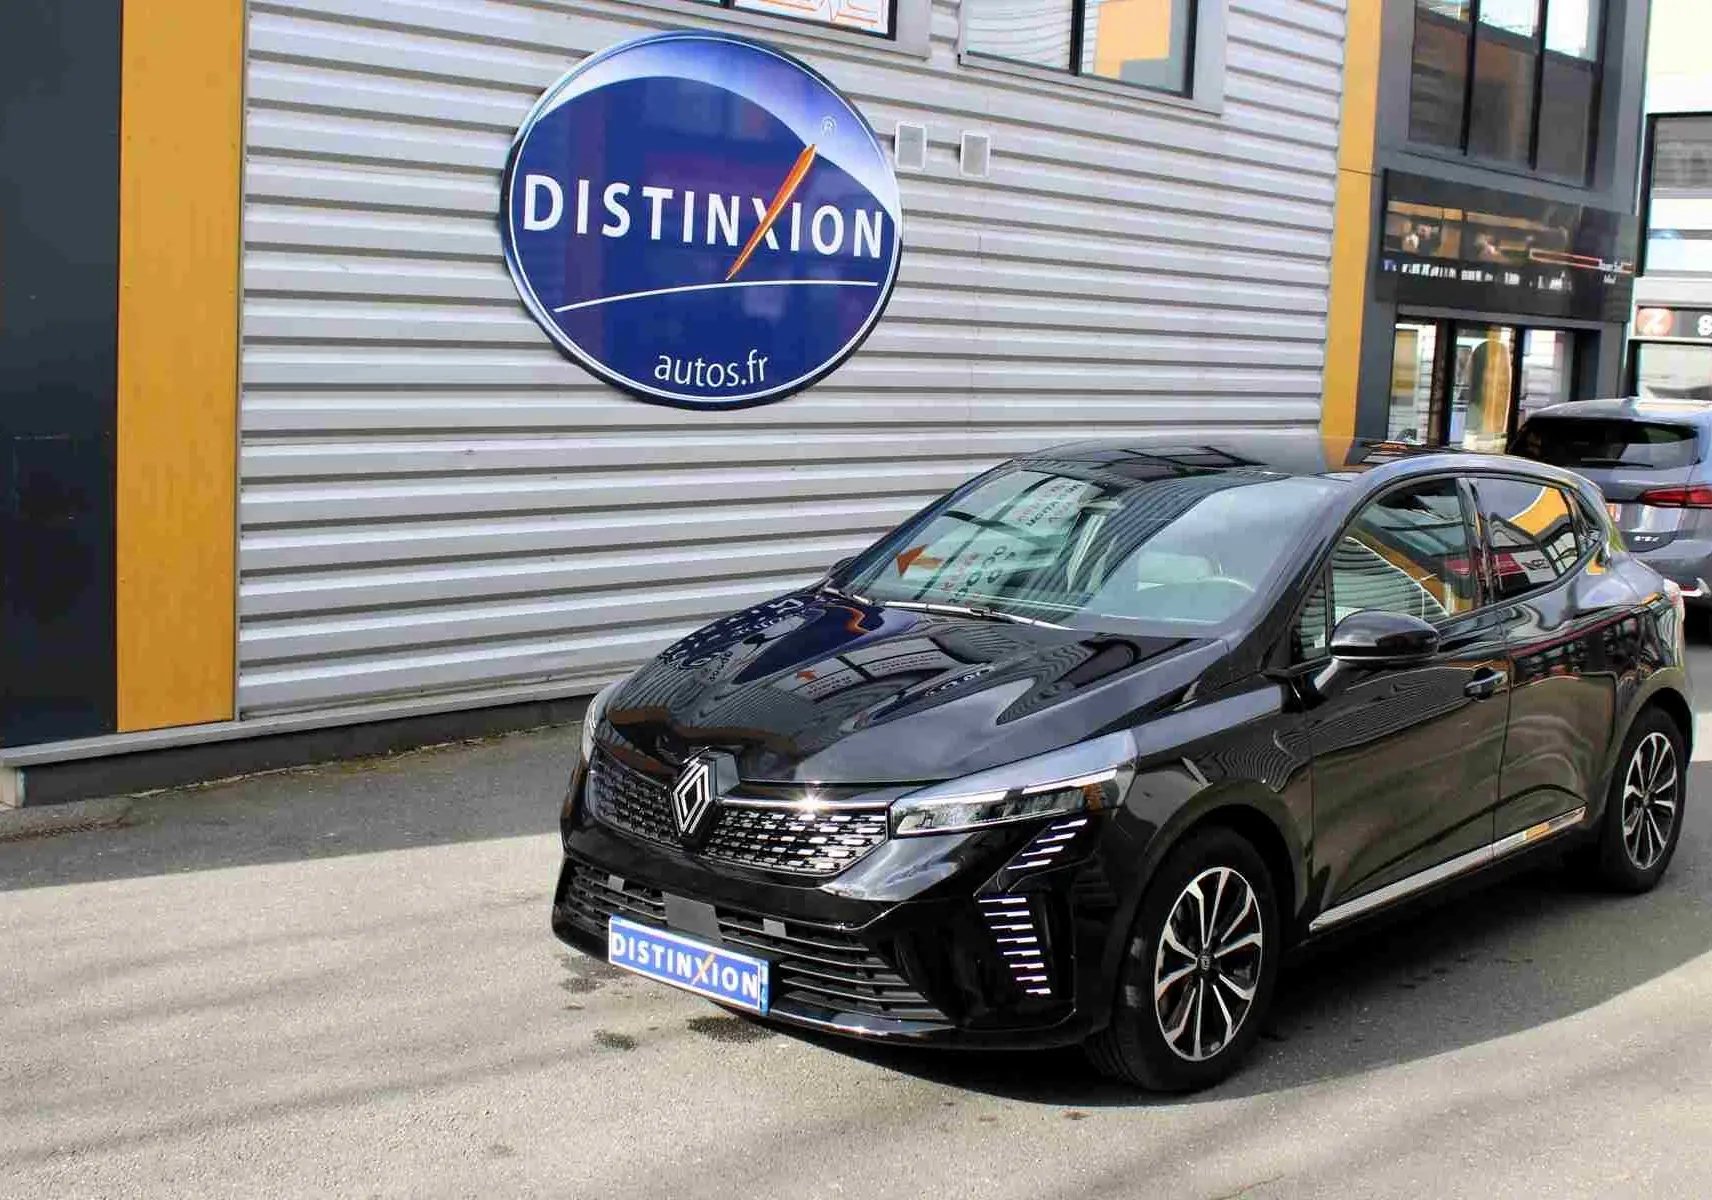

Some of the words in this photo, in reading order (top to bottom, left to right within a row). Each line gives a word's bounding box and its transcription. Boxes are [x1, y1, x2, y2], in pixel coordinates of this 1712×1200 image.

[524, 168, 883, 261] DISTINXION
[654, 349, 768, 387] autos.fr
[610, 932, 758, 1000] DISTINXION
